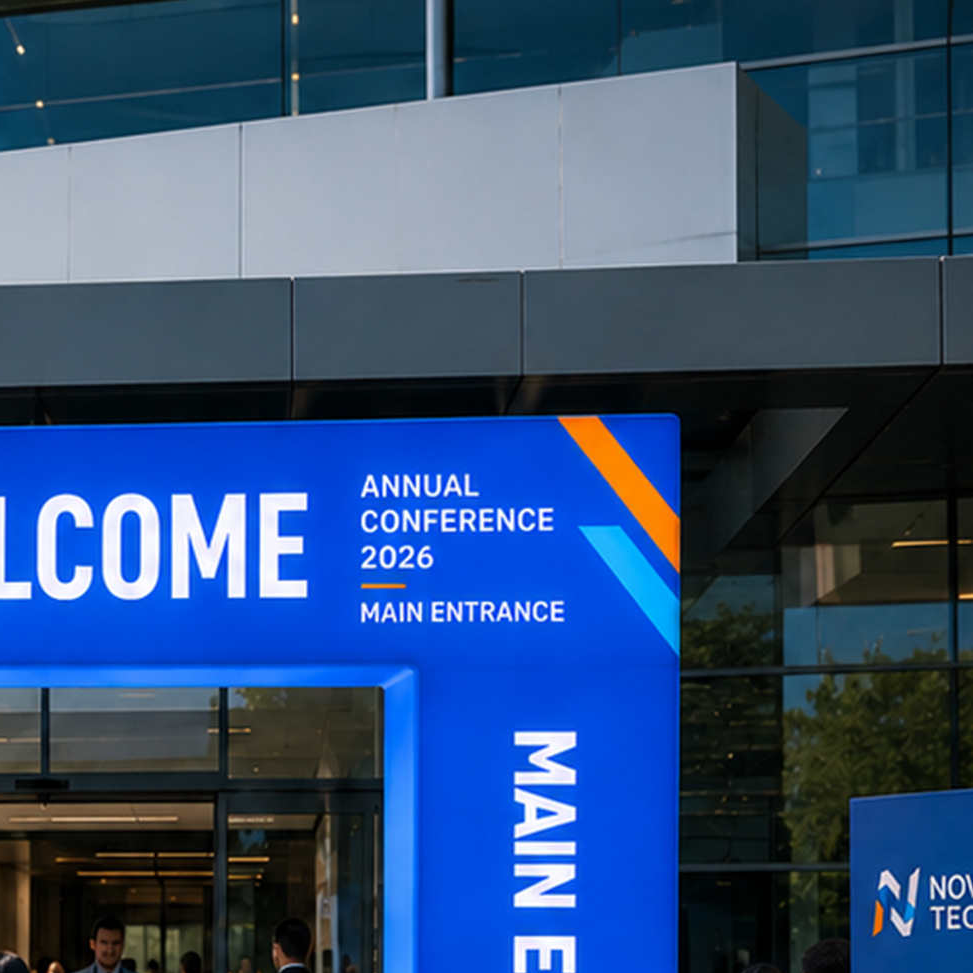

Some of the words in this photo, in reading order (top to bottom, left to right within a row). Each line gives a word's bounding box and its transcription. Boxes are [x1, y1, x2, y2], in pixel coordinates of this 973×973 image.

[360, 473, 480, 499] ANNUAL
[359, 507, 555, 535] CONFERENCE
[360, 544, 435, 570] 2026
[360, 601, 423, 623] MAIN
[430, 600, 566, 623] ENTRANCE
[513, 730, 577, 908] MAIN
